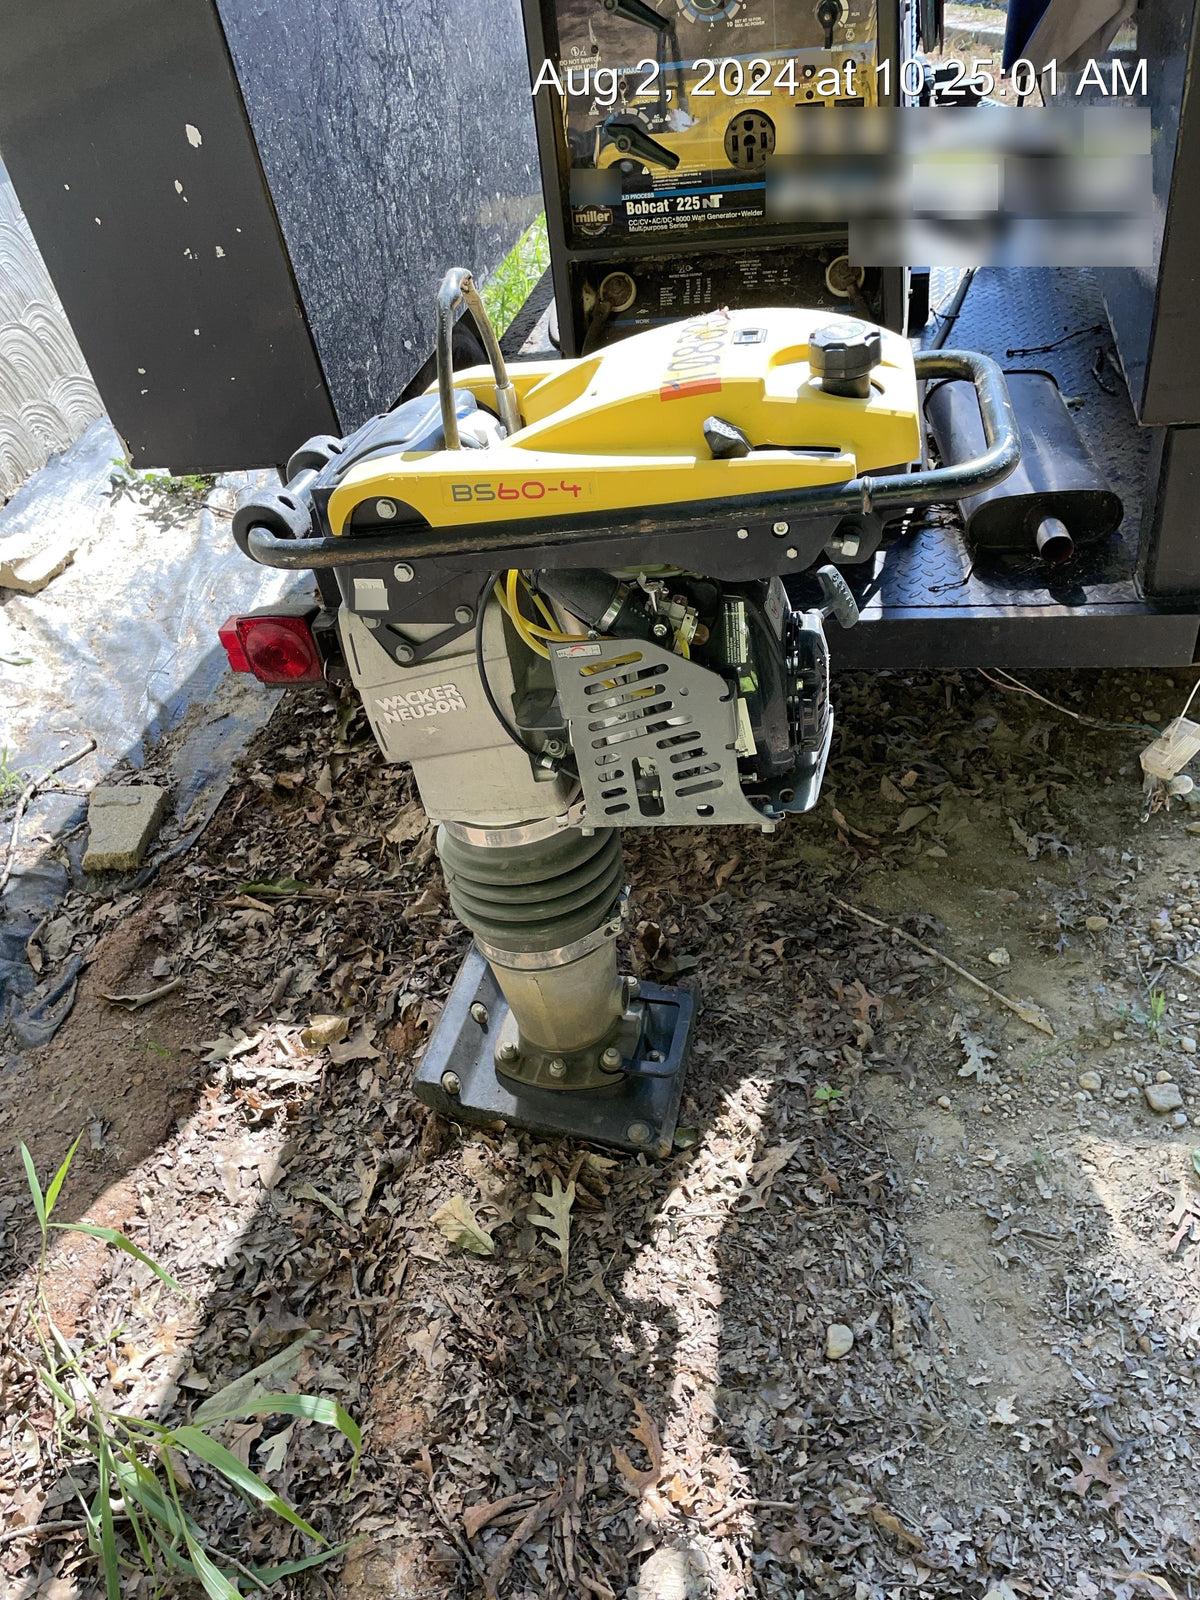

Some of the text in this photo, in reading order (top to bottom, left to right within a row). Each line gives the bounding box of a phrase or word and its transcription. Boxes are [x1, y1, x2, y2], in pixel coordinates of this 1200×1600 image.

[630, 192, 654, 200] PROCESS
[626, 194, 723, 216] Bobcat 225 NT
[575, 210, 610, 223] miller
[692, 214, 706, 222] Watt
[628, 222, 688, 233] Multipurpose Series
[451, 480, 582, 502] BS60-4
[375, 684, 461, 711] WACKER
[383, 697, 467, 724] NEUSON
